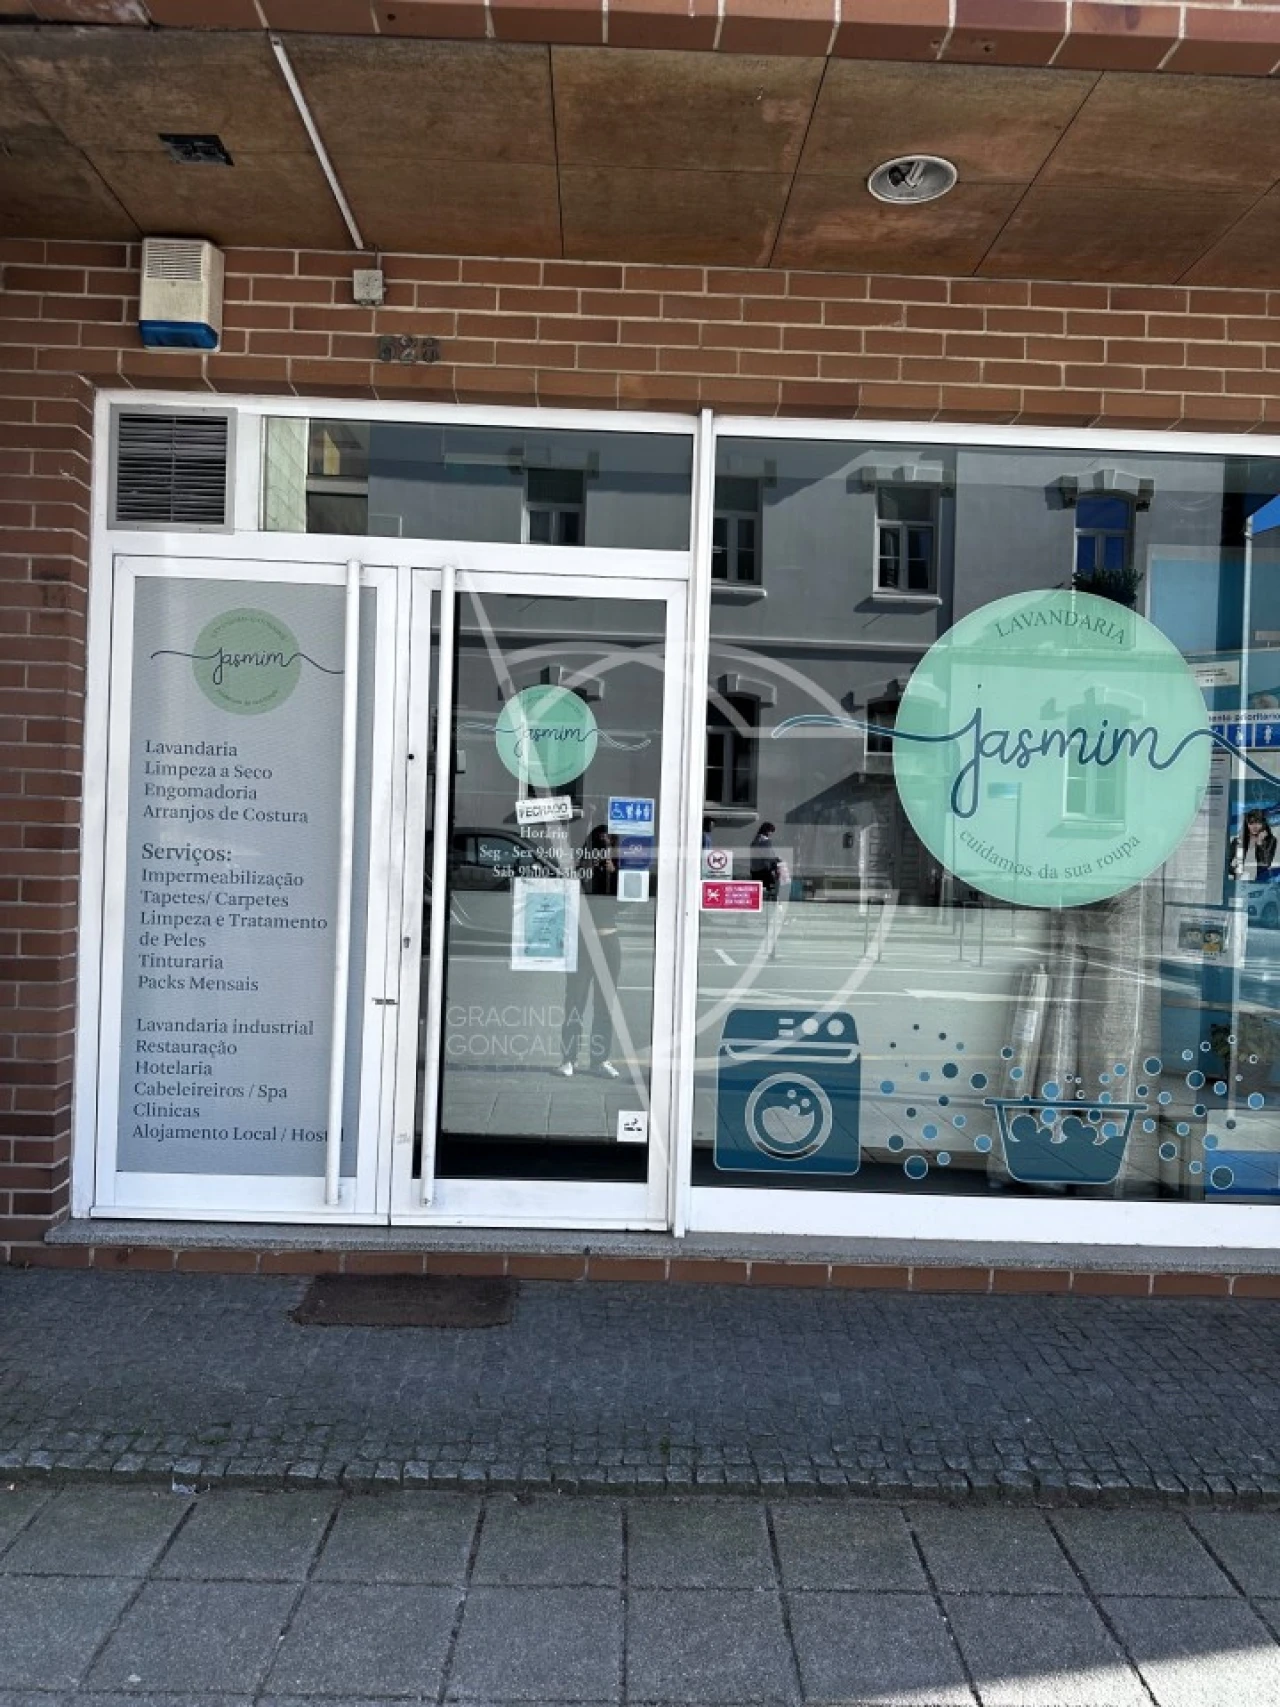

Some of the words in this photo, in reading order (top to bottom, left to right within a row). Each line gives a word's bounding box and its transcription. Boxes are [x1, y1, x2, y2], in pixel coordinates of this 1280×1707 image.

[995, 610, 1125, 645] LAVANDARIA
[145, 739, 238, 757] Lavandaria
[144, 760, 217, 781] Limpeza
[219, 766, 230, 778] a
[233, 763, 273, 780] Seco
[143, 782, 258, 801] Engomadoria
[142, 804, 214, 823] Arranjos
[218, 805, 239, 821] de
[242, 807, 309, 824] Costura
[141, 842, 233, 866] Serviços:
[959, 829, 1033, 878] cuidamos
[1037, 863, 1059, 880] da
[1064, 862, 1093, 879] sua
[1096, 834, 1141, 869] roupa
[141, 867, 305, 891] Impermeabilização
[140, 889, 211, 907] Tapetes/
[214, 892, 290, 911] Carpetes
[140, 910, 211, 928] Limpeza
[215, 915, 226, 927] e
[229, 912, 329, 930] Tratamento
[139, 930, 160, 947] de
[163, 932, 207, 948] Peles
[139, 953, 225, 970] Tinturaria
[137, 974, 186, 990] Packs
[188, 975, 260, 992] Mensais
[136, 1017, 229, 1035] Lavandaria
[231, 1018, 315, 1037] industrial
[135, 1038, 238, 1059] Restauração
[134, 1060, 213, 1076] Hotelaria
[134, 1080, 245, 1099] Cabeleireiros
[257, 1084, 289, 1103] Spa
[132, 1122, 229, 1143] Alojamento
[231, 1126, 277, 1142] Local
[291, 1126, 344, 1143] Hostl
